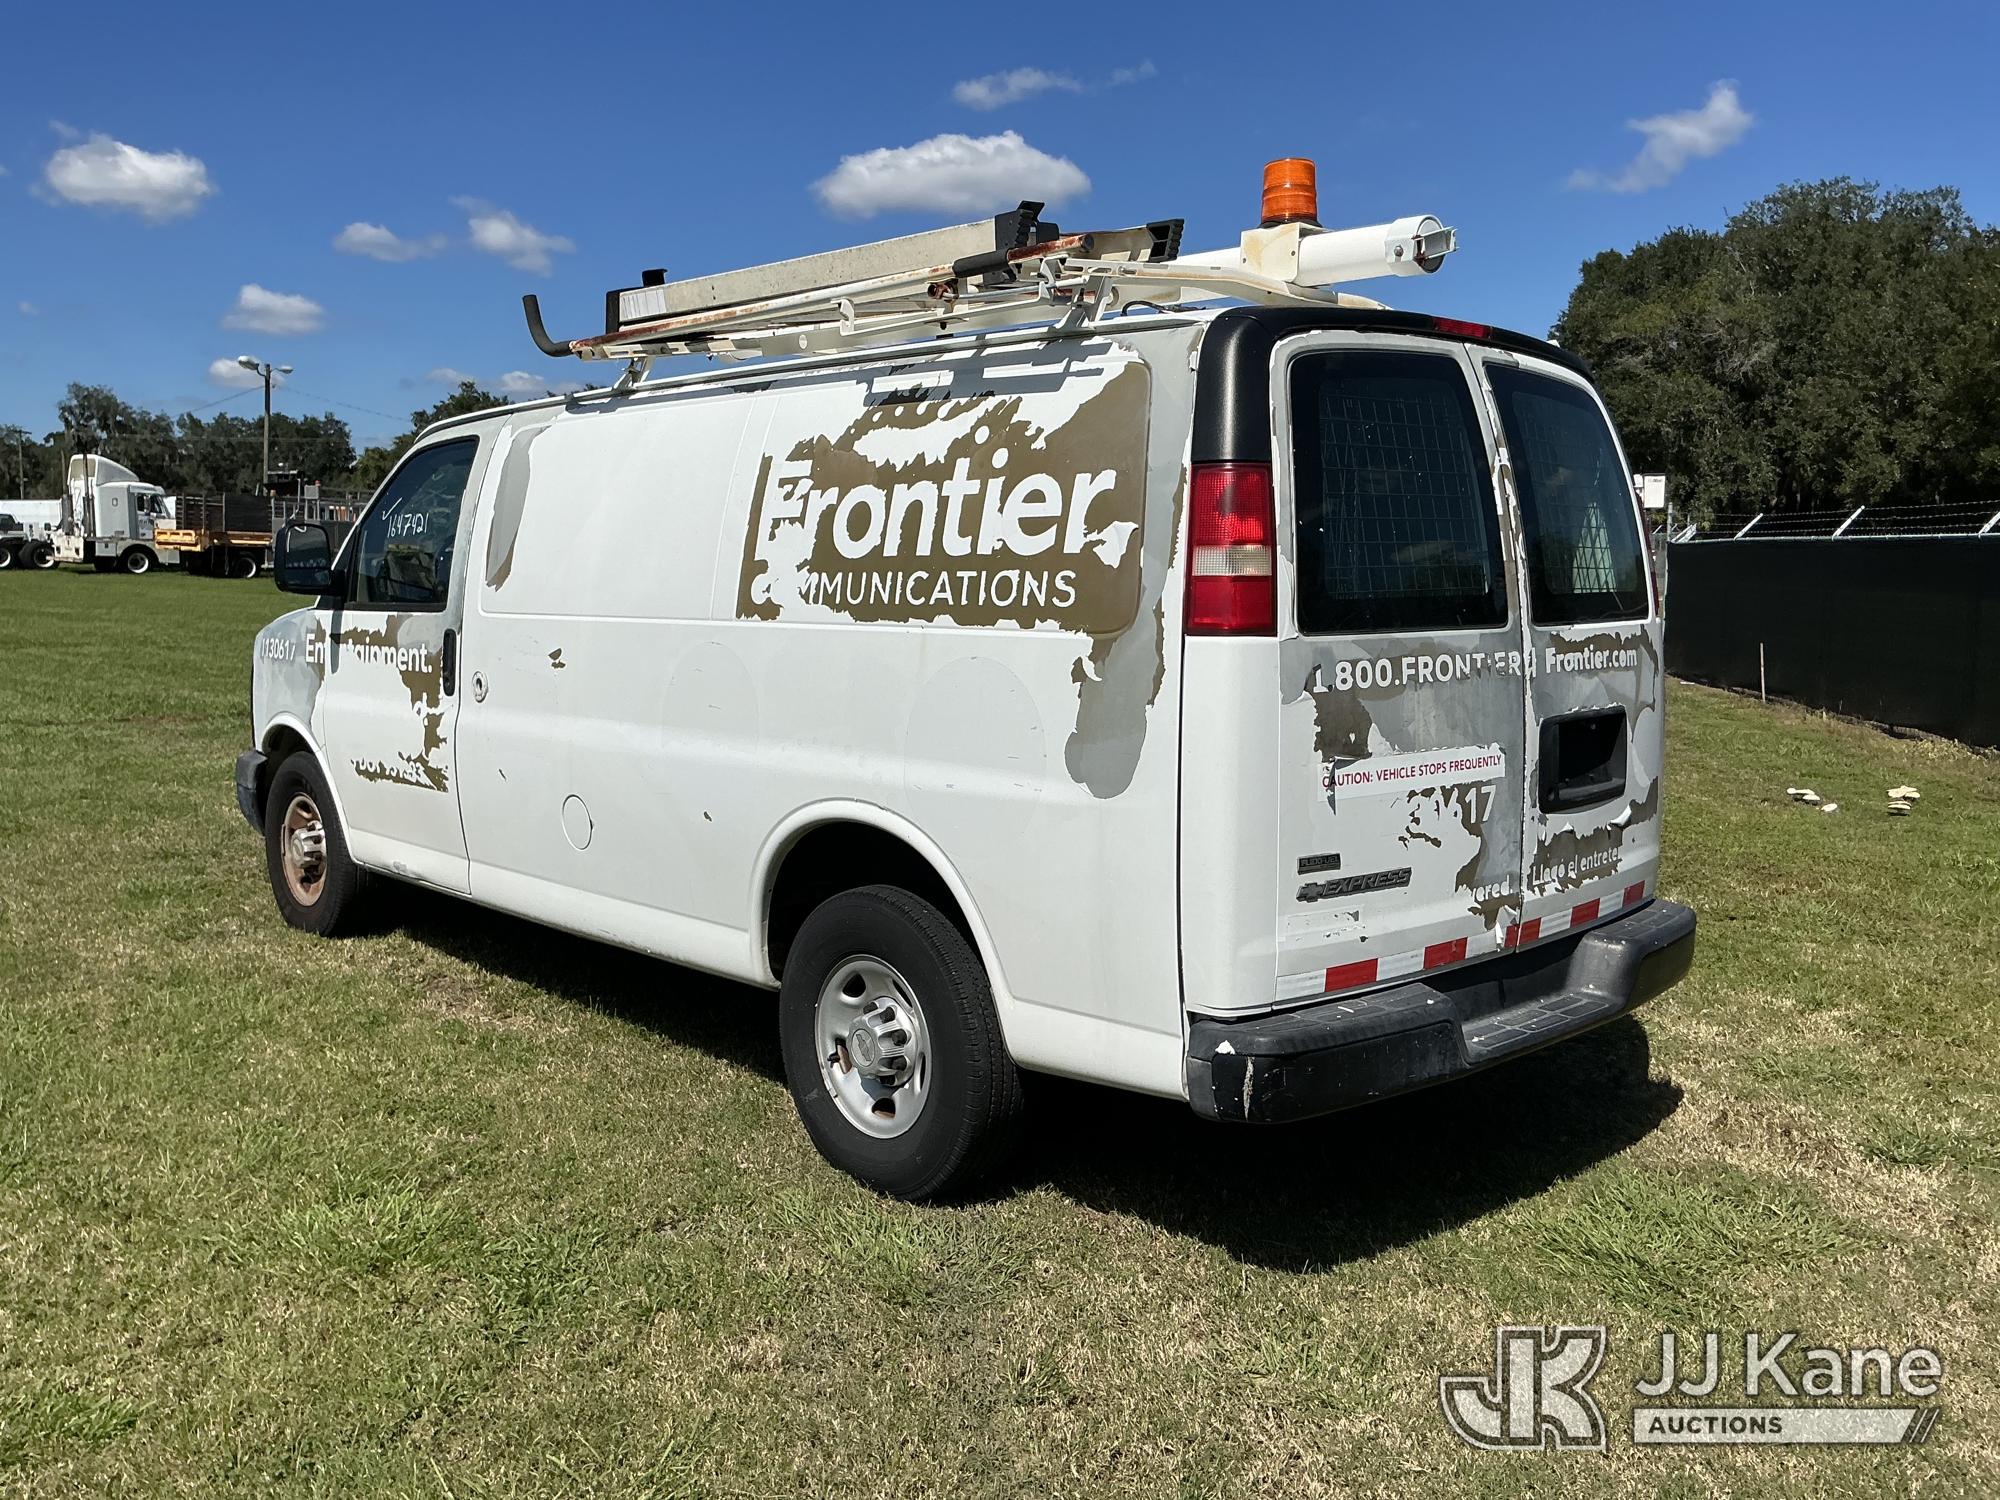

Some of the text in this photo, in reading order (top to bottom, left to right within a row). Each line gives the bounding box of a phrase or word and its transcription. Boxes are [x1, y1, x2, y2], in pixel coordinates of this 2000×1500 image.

[755, 448, 1116, 561] Frontier
[387, 513, 429, 538] 1647421
[751, 567, 1077, 607] CMMUNICATIONS
[1546, 646, 1638, 674] Frontier.com
[1322, 754, 1502, 788] CAUTION: VEHICLE STOPS FREQUENTLY
[1581, 846, 1622, 871] entrete
[1323, 869, 1411, 896] EXPRESS
